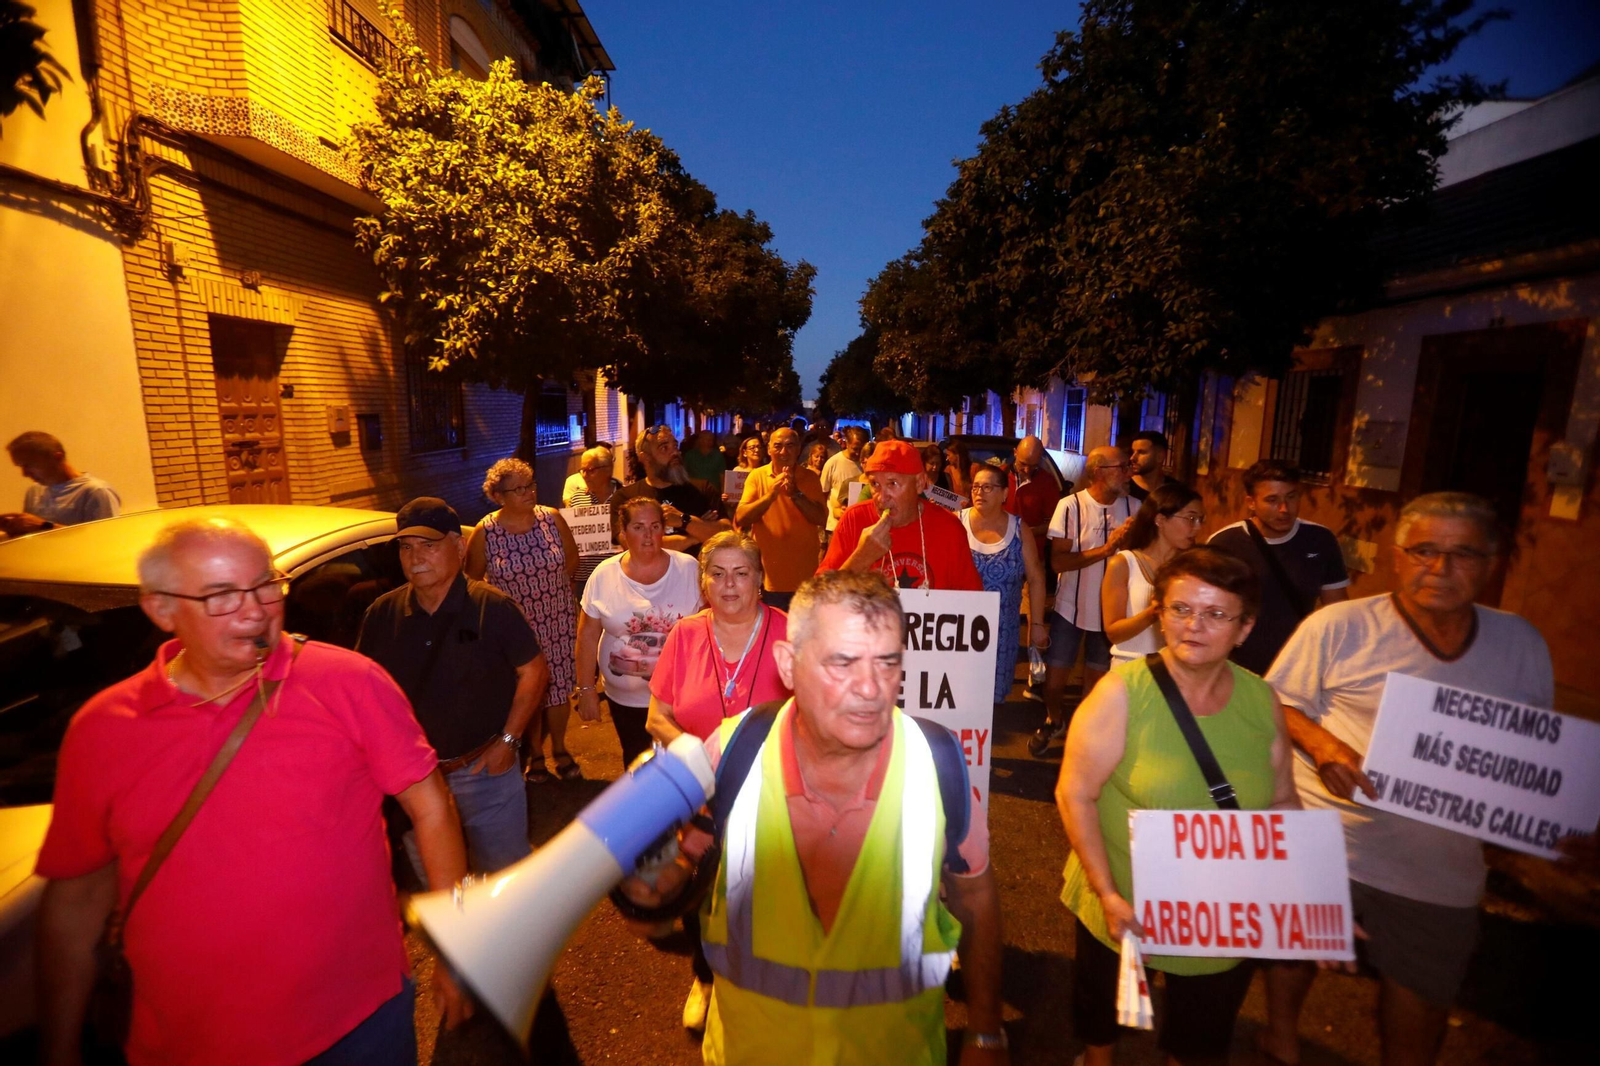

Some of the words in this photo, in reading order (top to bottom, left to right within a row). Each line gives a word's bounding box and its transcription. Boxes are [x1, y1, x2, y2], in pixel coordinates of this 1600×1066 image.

[574, 506, 600, 517] LIMPIEZA
[598, 523, 605, 533] DE
[585, 541, 609, 552] LINDERO
[919, 671, 956, 709] LA
[1432, 686, 1563, 744] NECESITAMOS
[1412, 731, 1454, 768] MÁS
[1455, 745, 1563, 797] SEGURIDAD
[1173, 813, 1246, 860] PODA
[1251, 814, 1288, 860] DE
[1389, 777, 1487, 829] NUESTRAS
[1488, 806, 1561, 850] CALLES
[1141, 900, 1263, 950] ARBOLES
